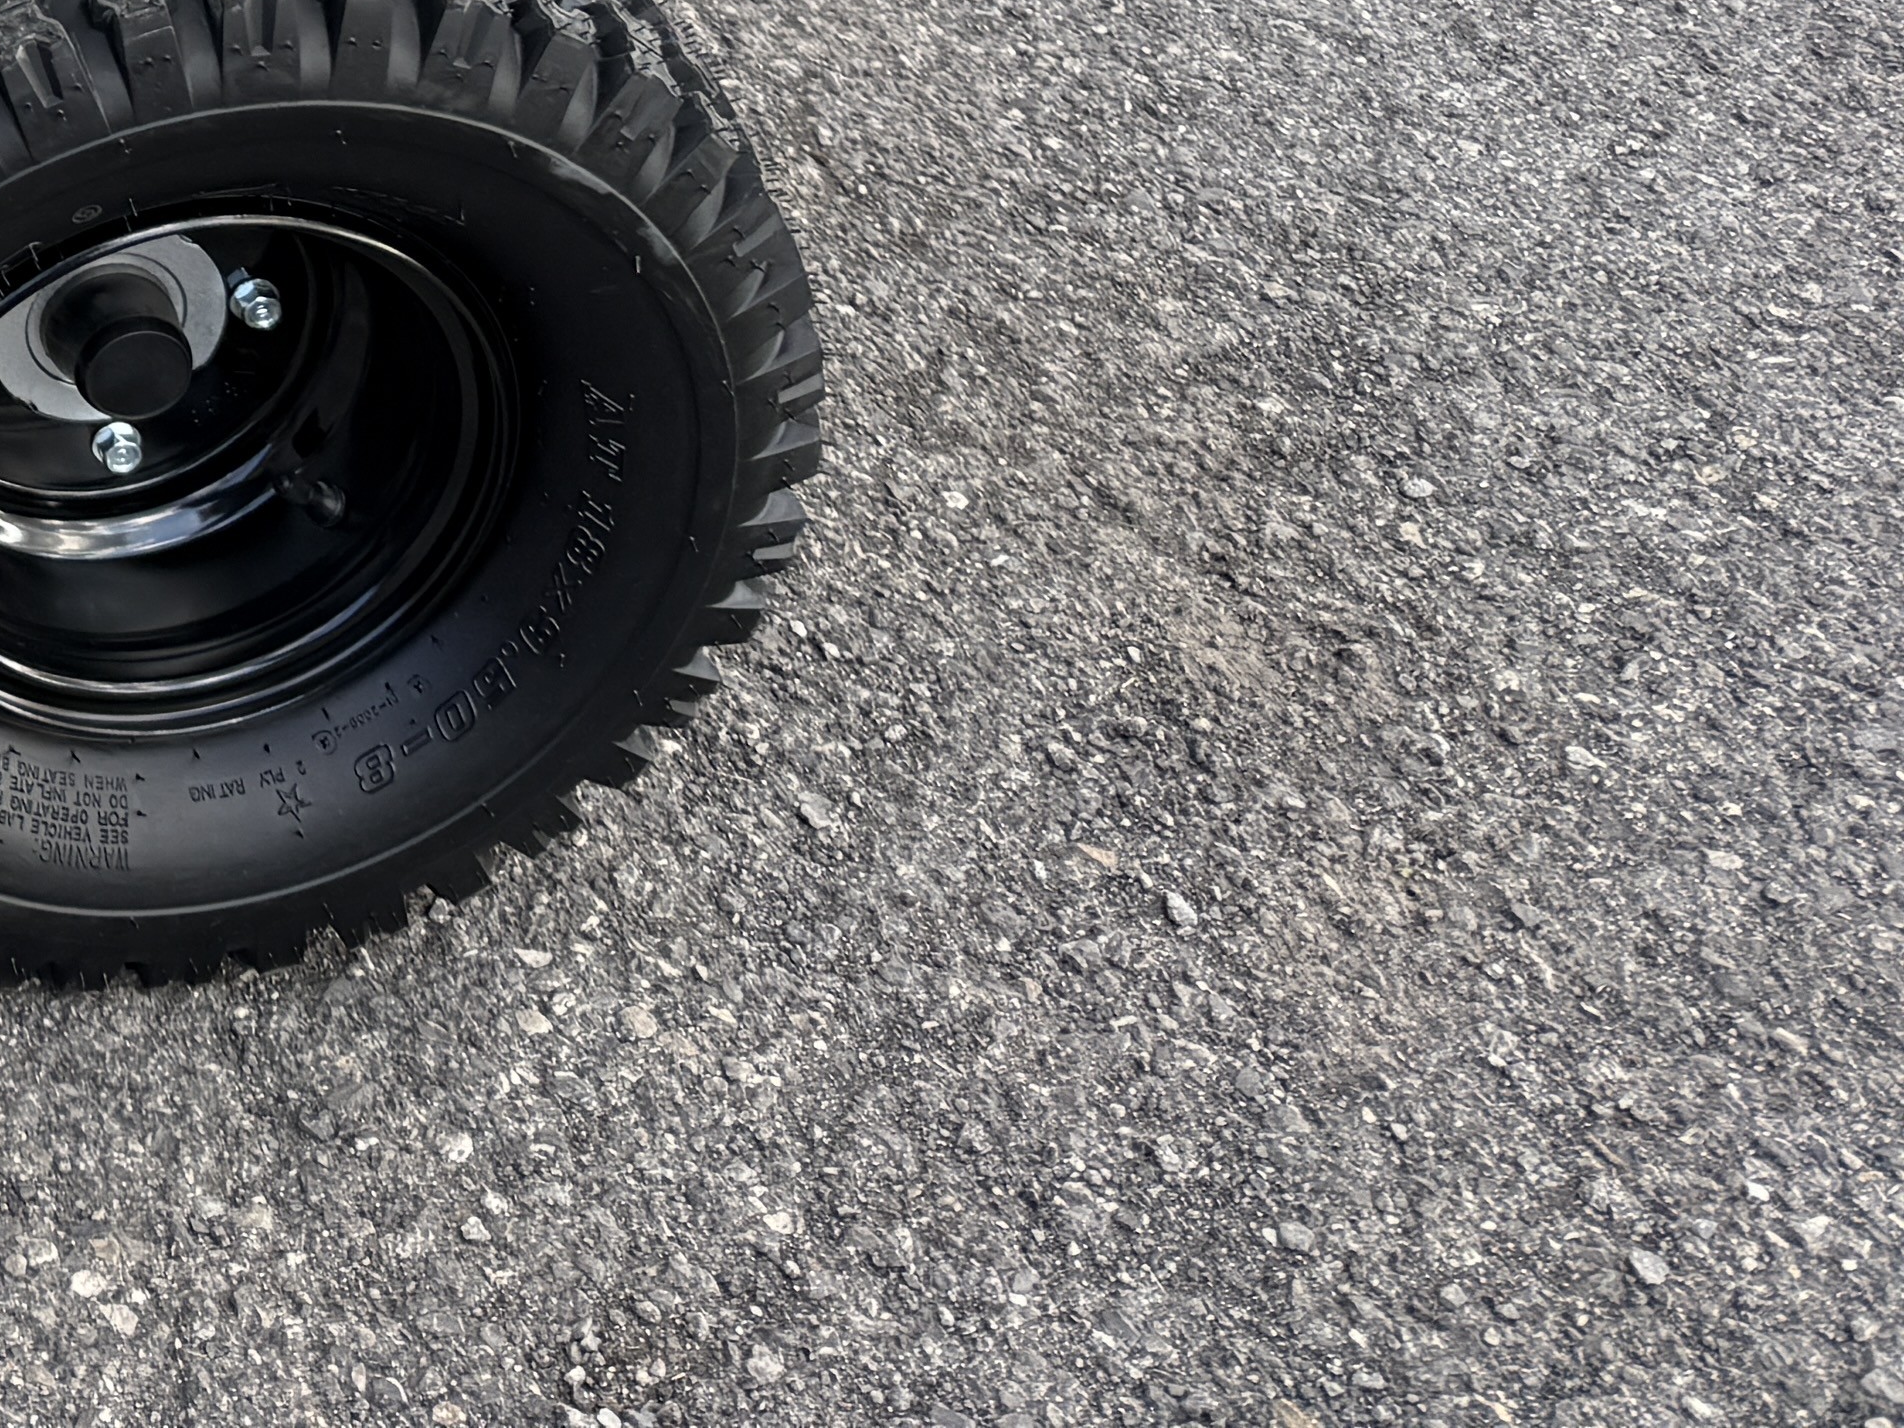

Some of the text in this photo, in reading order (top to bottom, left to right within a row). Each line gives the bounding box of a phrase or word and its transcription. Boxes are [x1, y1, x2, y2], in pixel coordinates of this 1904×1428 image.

[15, 758, 76, 786] SEATING
[83, 771, 126, 792] WHEN
[256, 765, 285, 788] PLY
[8, 773, 66, 802] INFLATE
[72, 789, 100, 806] NOT
[187, 776, 245, 803] RATING
[9, 793, 88, 824] OPERATING
[107, 792, 127, 809] DO
[95, 808, 128, 826] FOR
[30, 817, 90, 841] VEHICLE
[97, 827, 128, 844] SEE
